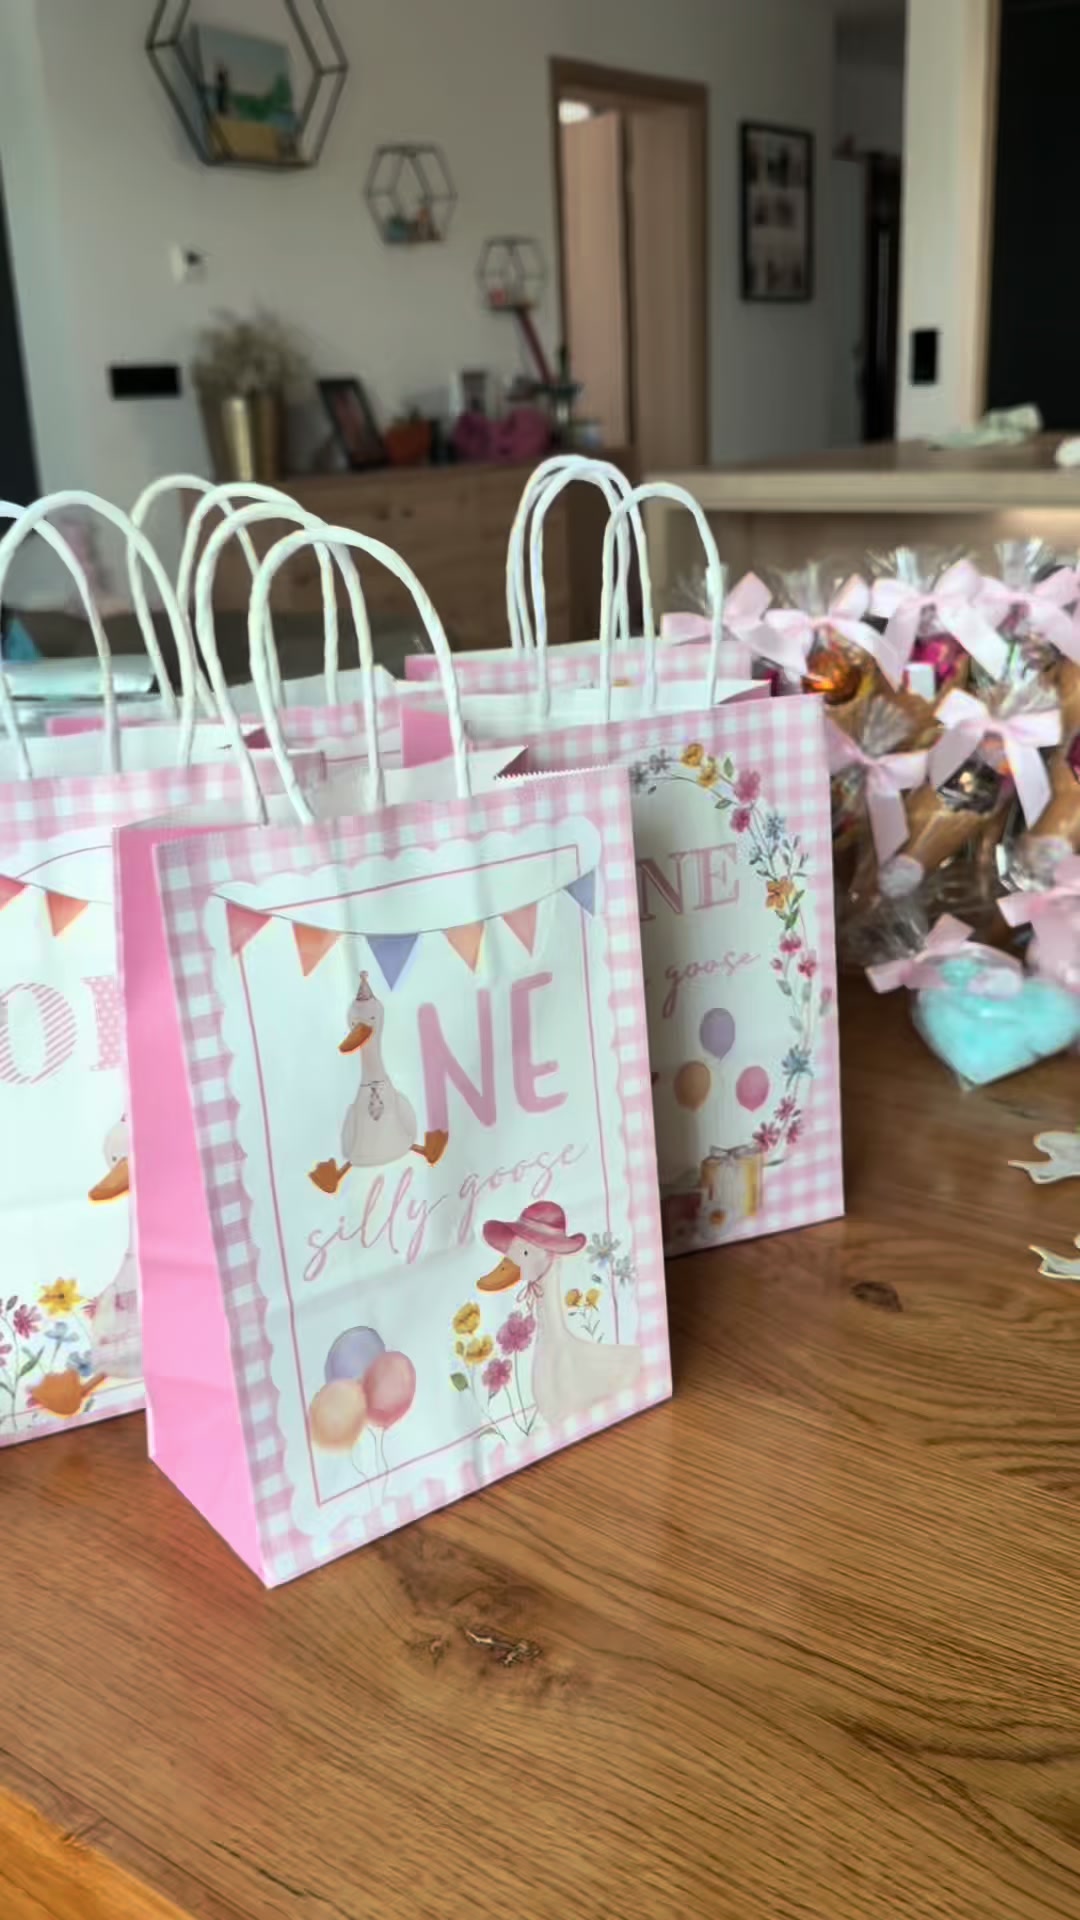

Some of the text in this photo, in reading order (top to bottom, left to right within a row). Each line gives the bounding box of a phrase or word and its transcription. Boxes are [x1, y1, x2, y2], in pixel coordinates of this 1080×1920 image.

[636, 842, 740, 923] NE
[661, 950, 761, 1020] goose
[303, 1143, 589, 1282] silly goose
